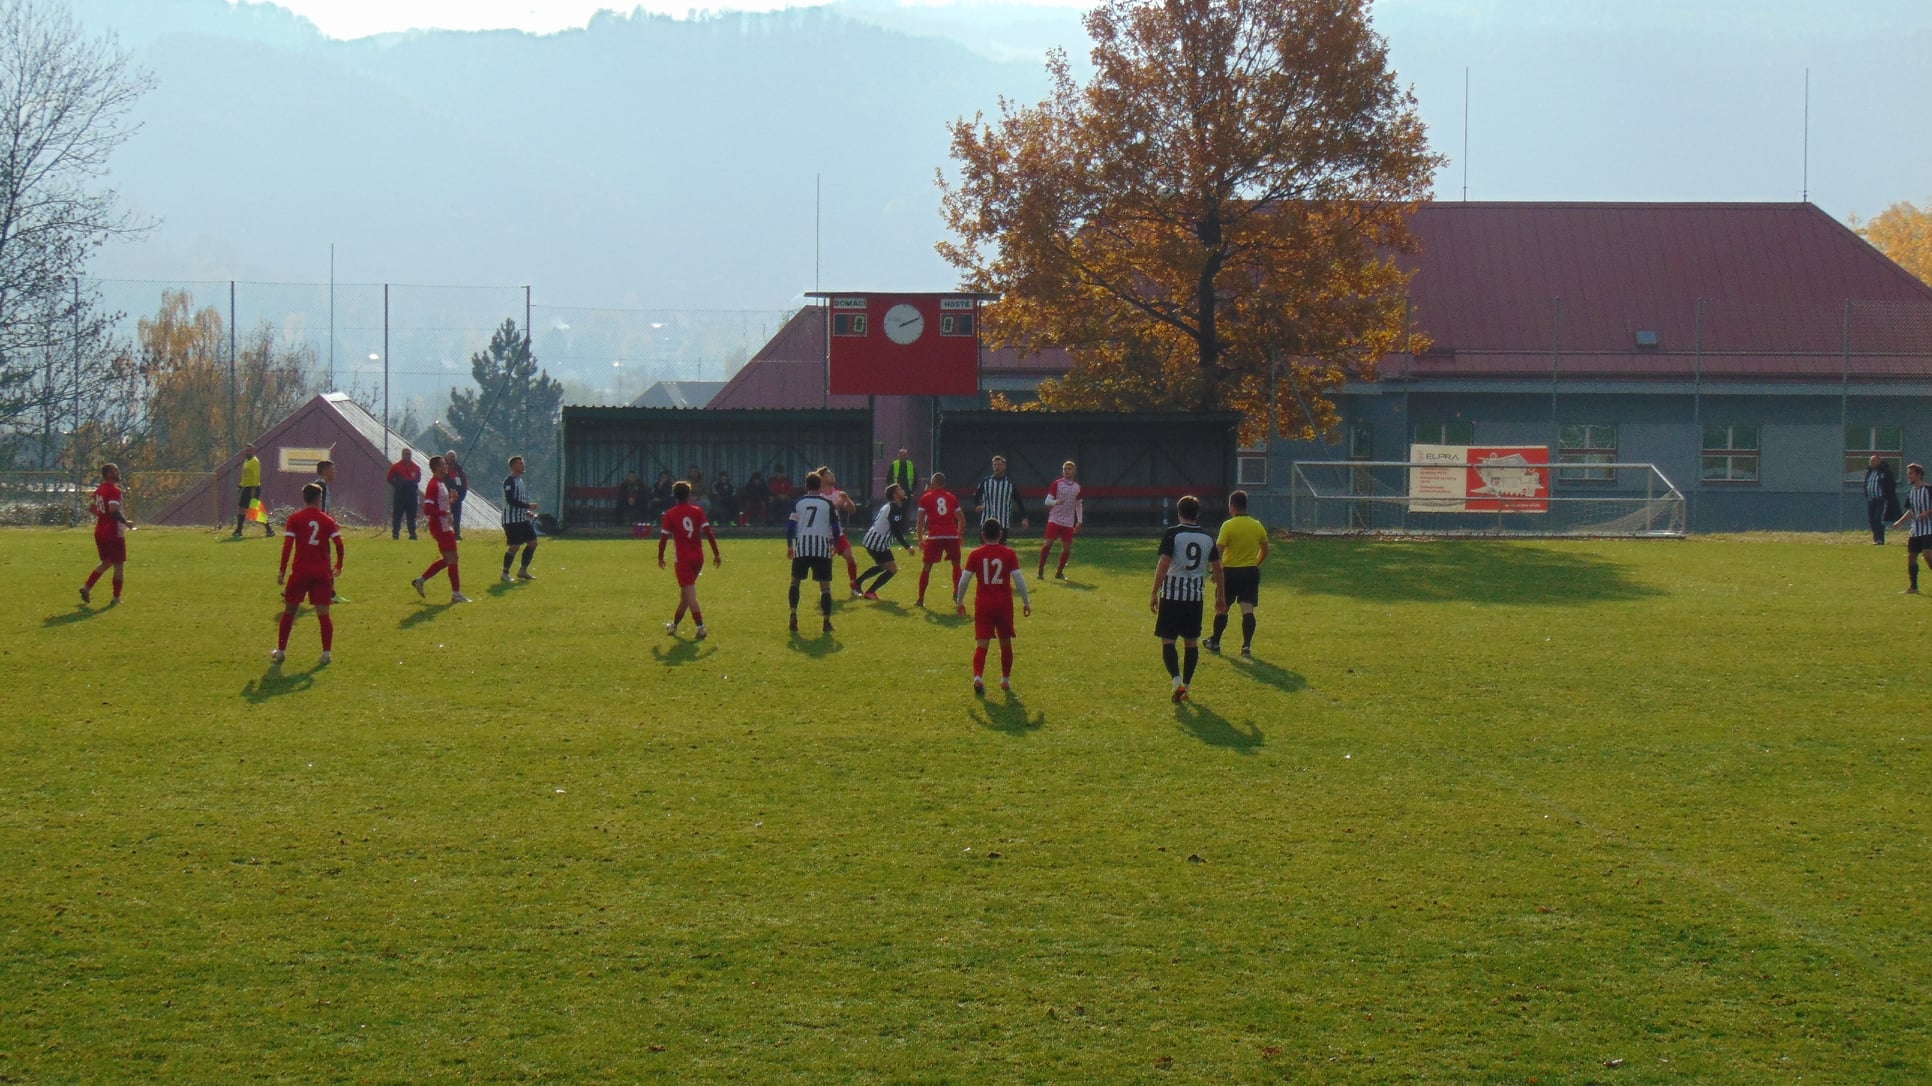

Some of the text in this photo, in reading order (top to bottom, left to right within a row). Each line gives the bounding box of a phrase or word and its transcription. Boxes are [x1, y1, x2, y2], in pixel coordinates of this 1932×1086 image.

[853, 315, 865, 333] 0
[942, 316, 954, 333] 0
[1426, 453, 1459, 461] ELPRA
[806, 506, 817, 528] 7
[936, 496, 947, 516] 8
[308, 520, 320, 546] 2
[682, 516, 694, 538] 9
[1185, 541, 1202, 571] 9
[982, 558, 1004, 585] 12
